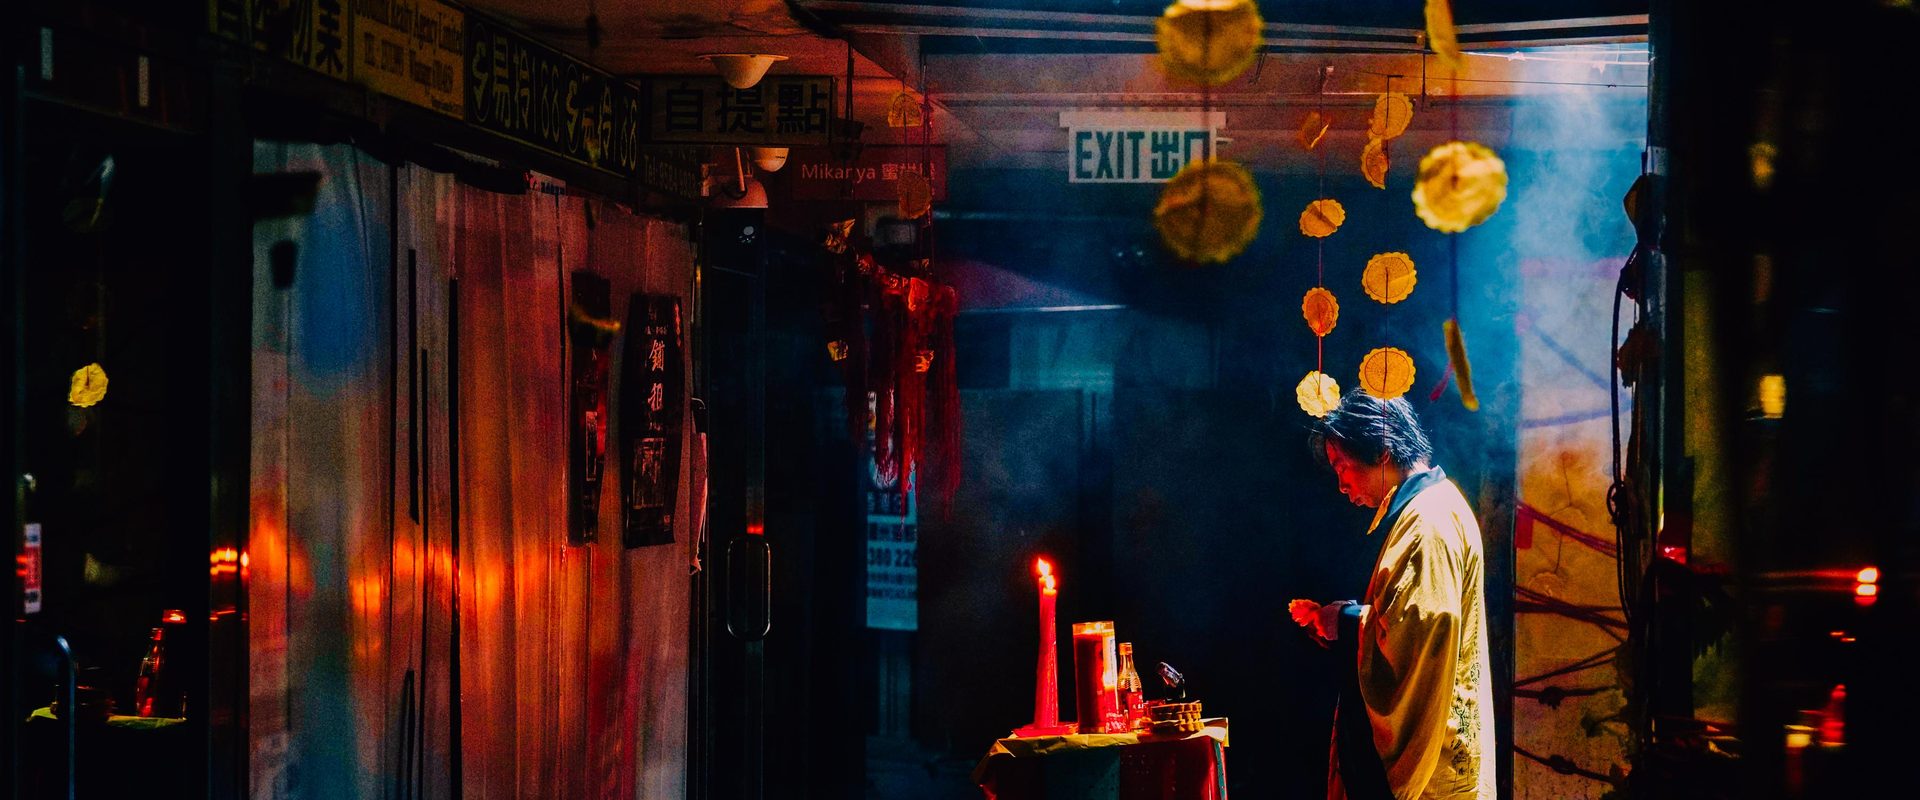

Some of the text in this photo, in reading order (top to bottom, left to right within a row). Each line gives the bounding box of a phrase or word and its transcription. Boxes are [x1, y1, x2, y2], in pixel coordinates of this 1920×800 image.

[666, 80, 828, 133] 自提點
[1075, 131, 1210, 179] EXIT 出口
